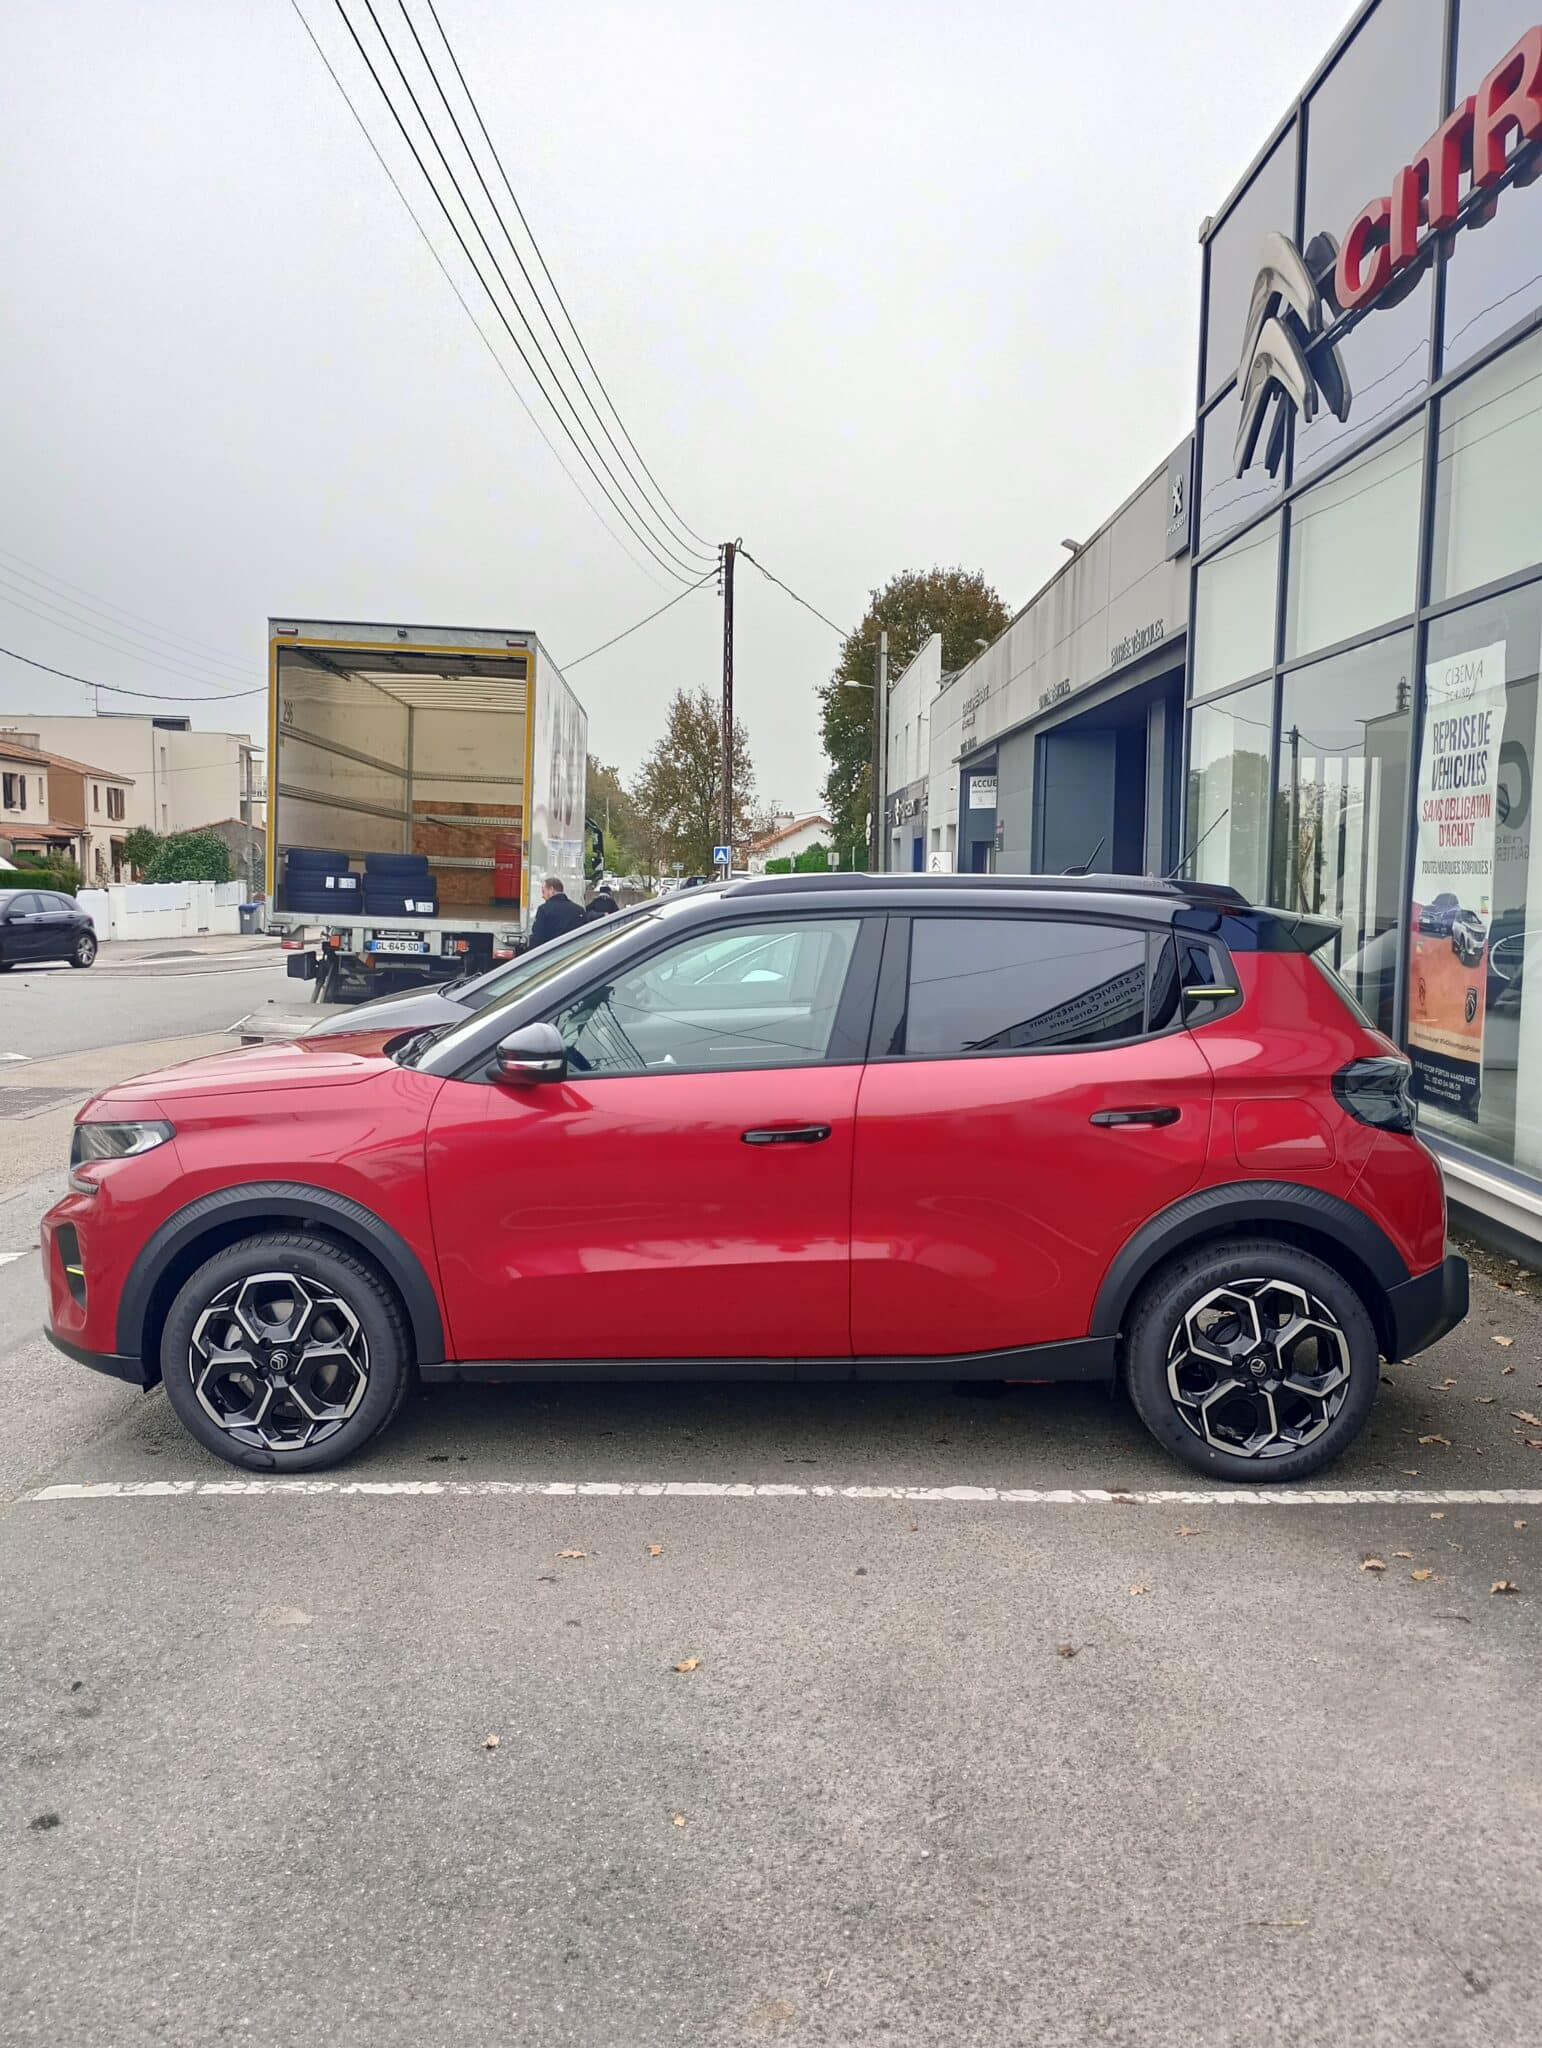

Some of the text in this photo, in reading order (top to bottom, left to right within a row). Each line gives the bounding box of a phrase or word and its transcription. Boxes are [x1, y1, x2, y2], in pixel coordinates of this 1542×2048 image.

[1335, 25, 1542, 310] CITR
[1433, 710, 1493, 755] REPRISE DE
[1423, 798, 1443, 822] SANS
[1439, 823, 1475, 847] D'ACHAT
